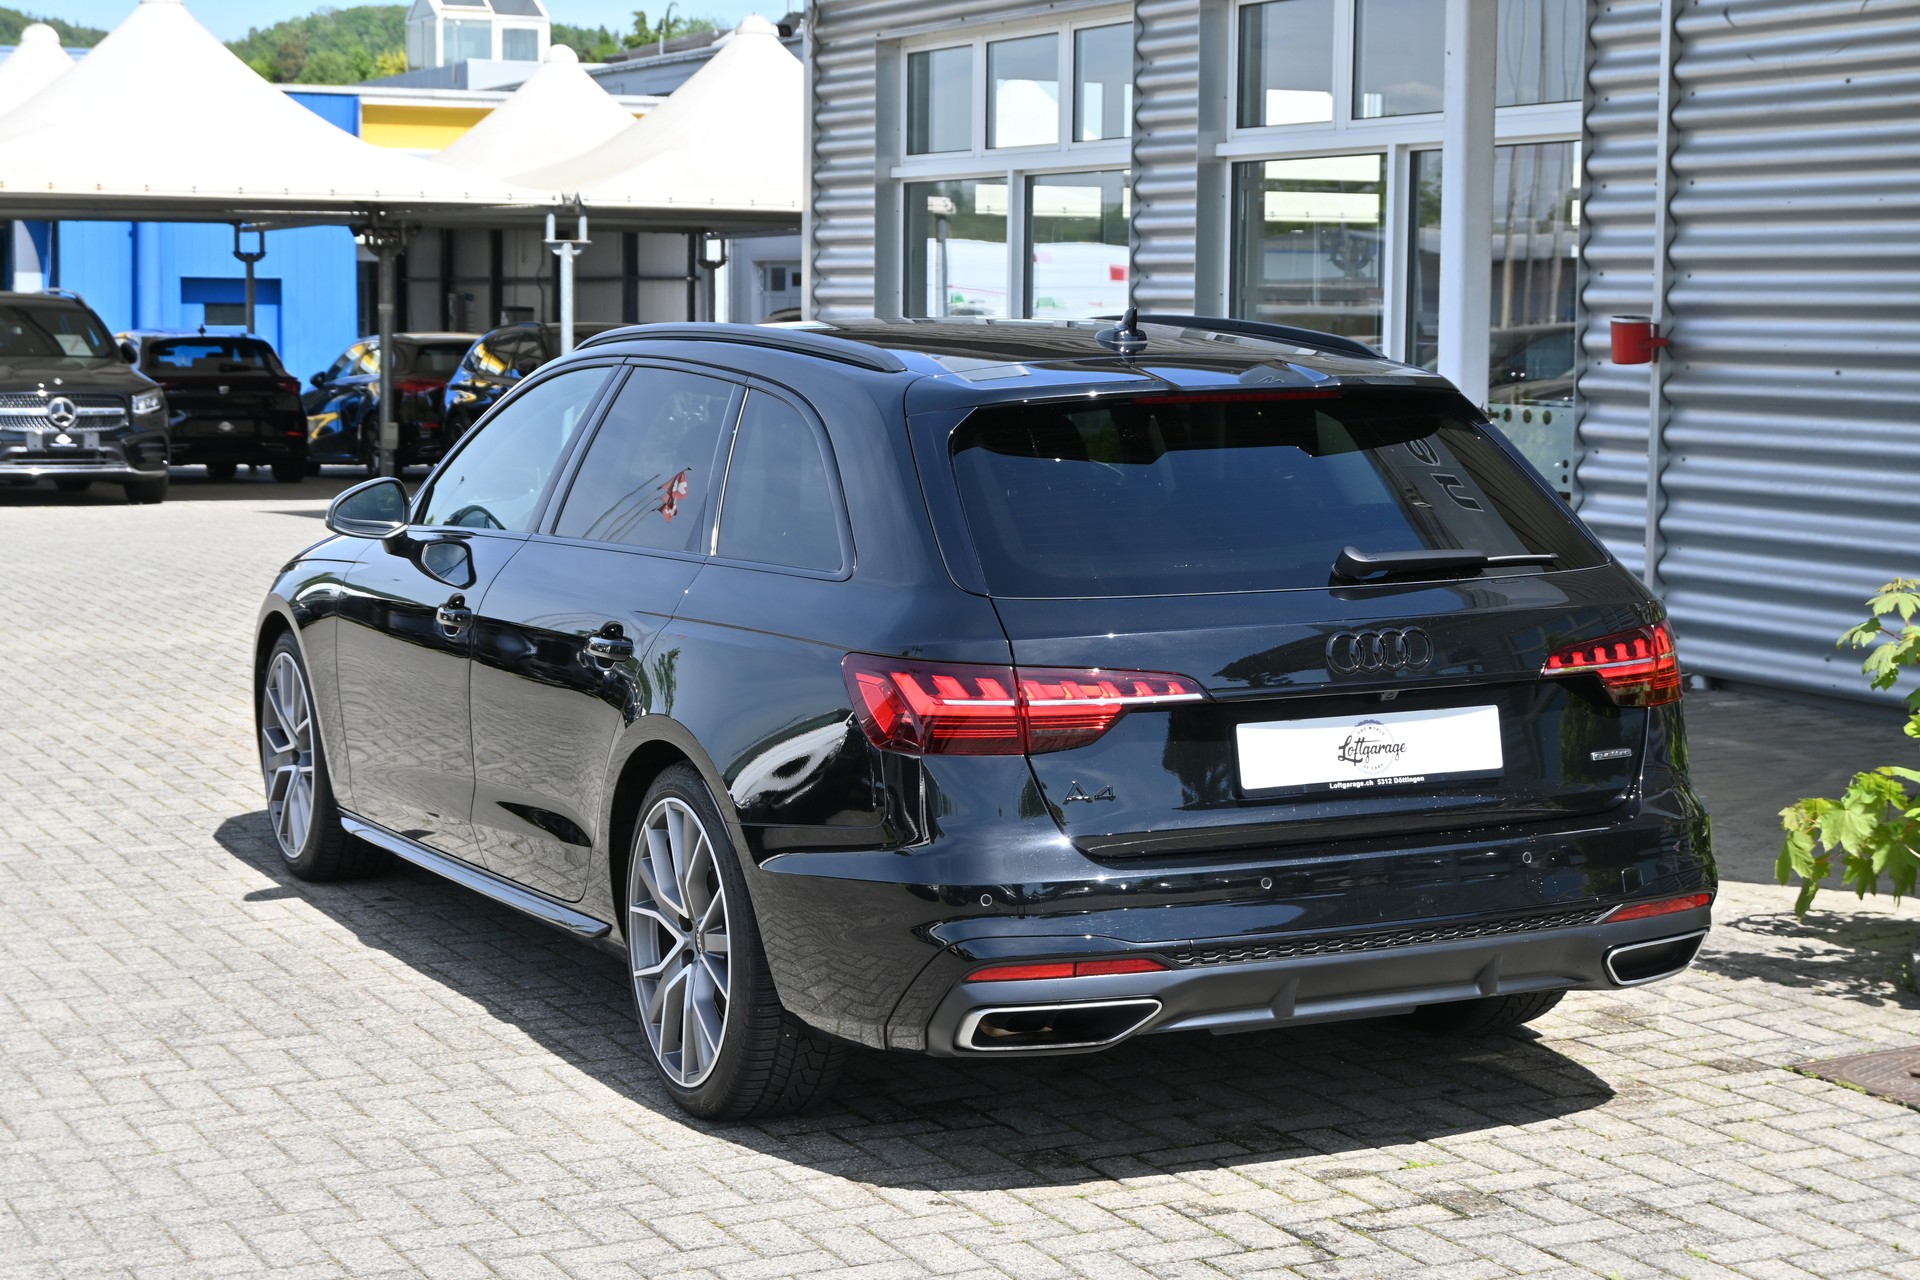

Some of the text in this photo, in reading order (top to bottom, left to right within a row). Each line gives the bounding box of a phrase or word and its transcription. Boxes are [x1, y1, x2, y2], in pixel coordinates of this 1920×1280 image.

[1338, 735, 1407, 766] Loftgarage
[1063, 780, 1116, 805] A4
[1329, 780, 1374, 789] Loftgarage.ch
